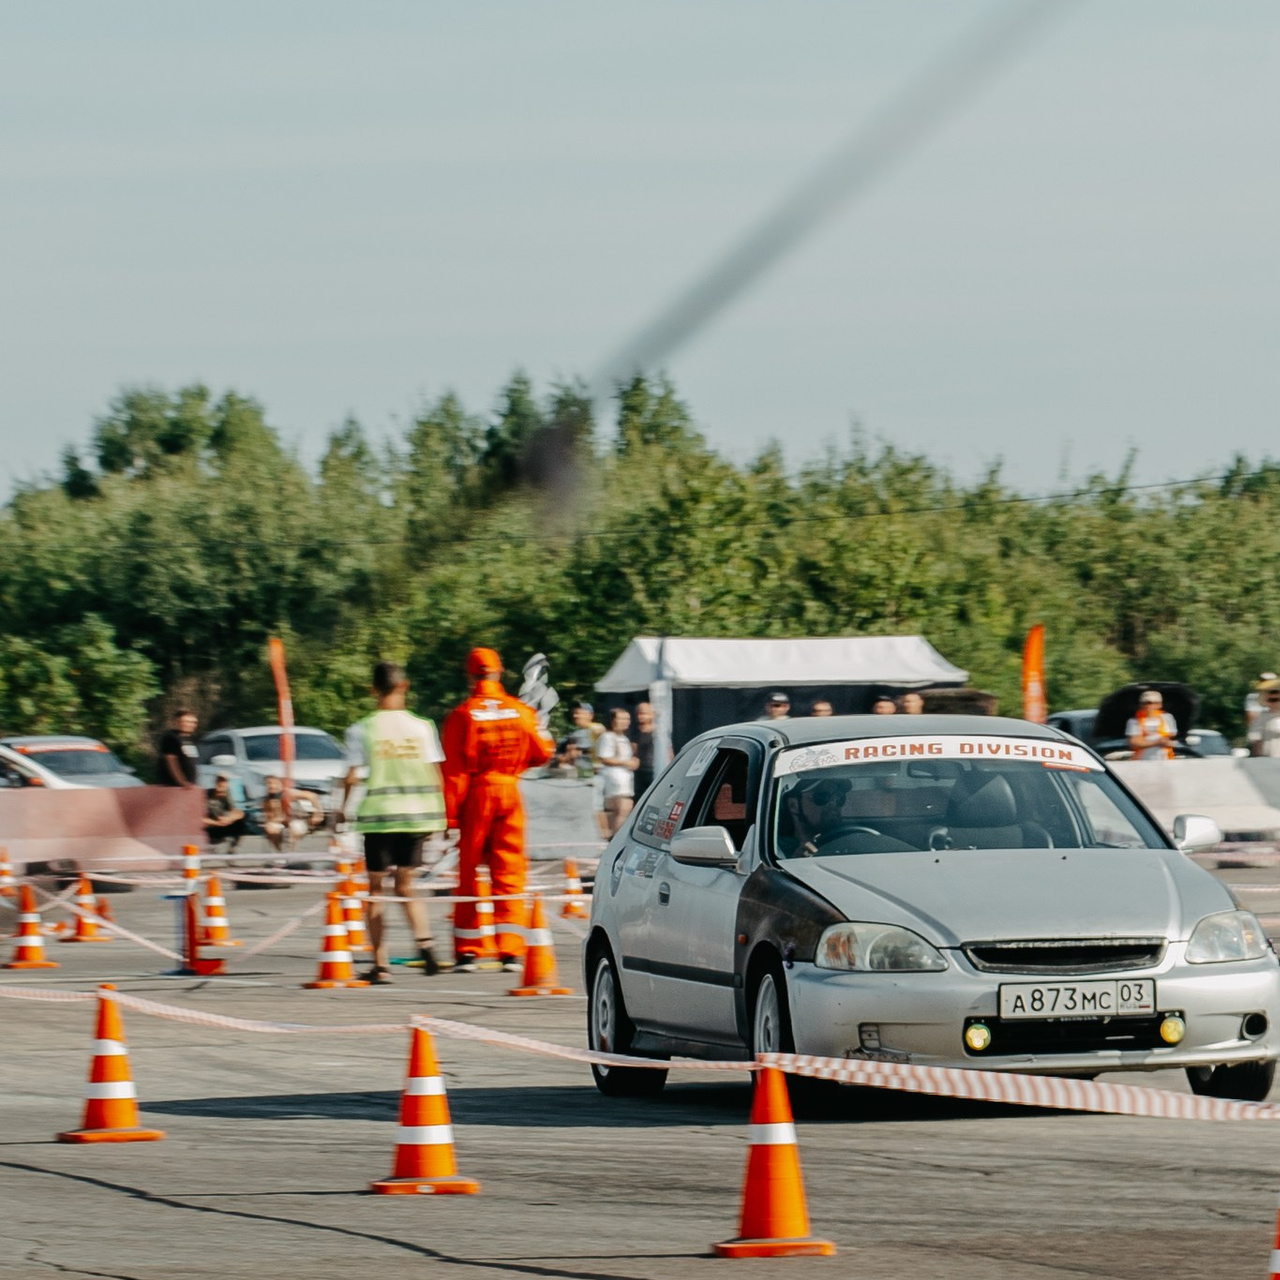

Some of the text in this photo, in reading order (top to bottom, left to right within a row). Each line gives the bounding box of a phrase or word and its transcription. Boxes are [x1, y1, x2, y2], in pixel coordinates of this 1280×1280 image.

[844, 742, 1073, 761] RACING DIVISION
[1012, 983, 1144, 1014] A873MC 03
